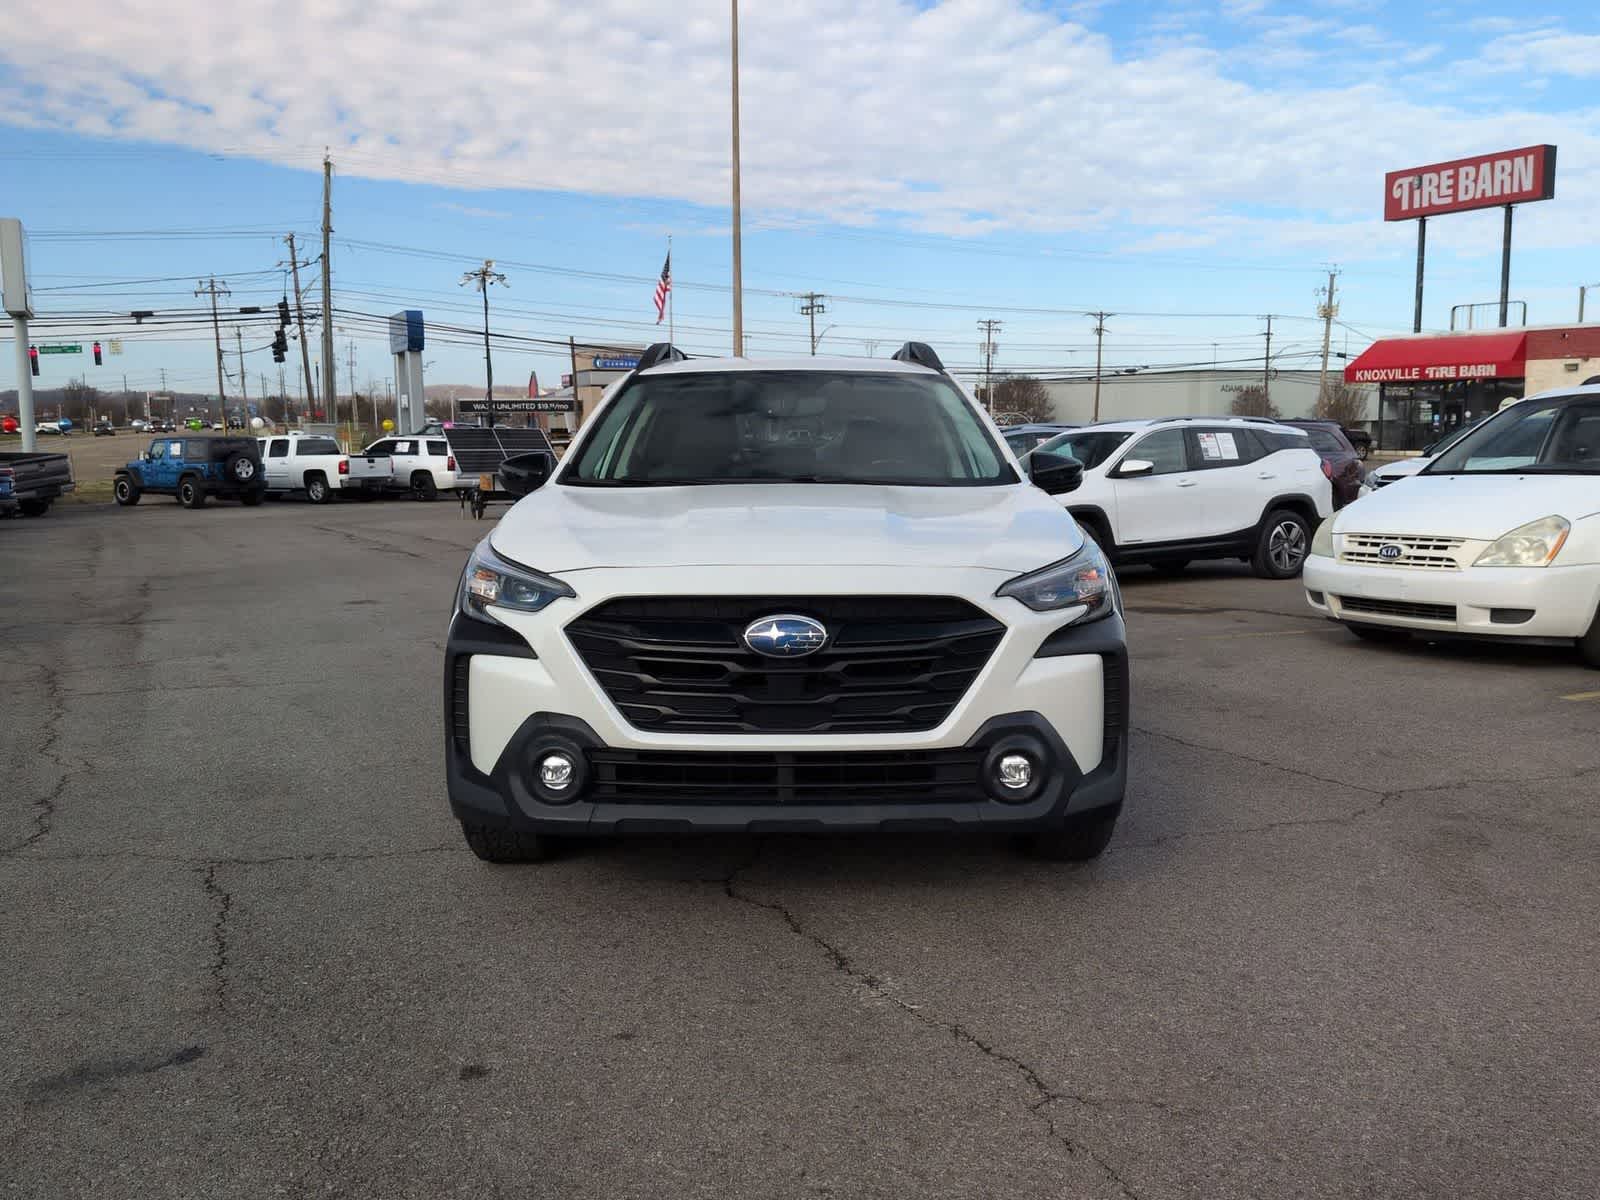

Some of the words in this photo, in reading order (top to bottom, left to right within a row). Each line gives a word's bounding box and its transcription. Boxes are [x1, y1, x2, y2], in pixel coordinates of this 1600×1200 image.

[1458, 154, 1535, 202] BARN
[1355, 367, 1420, 381] KNOXVILLE
[1460, 364, 1497, 377] BARN
[1381, 547, 1398, 557] KIA
